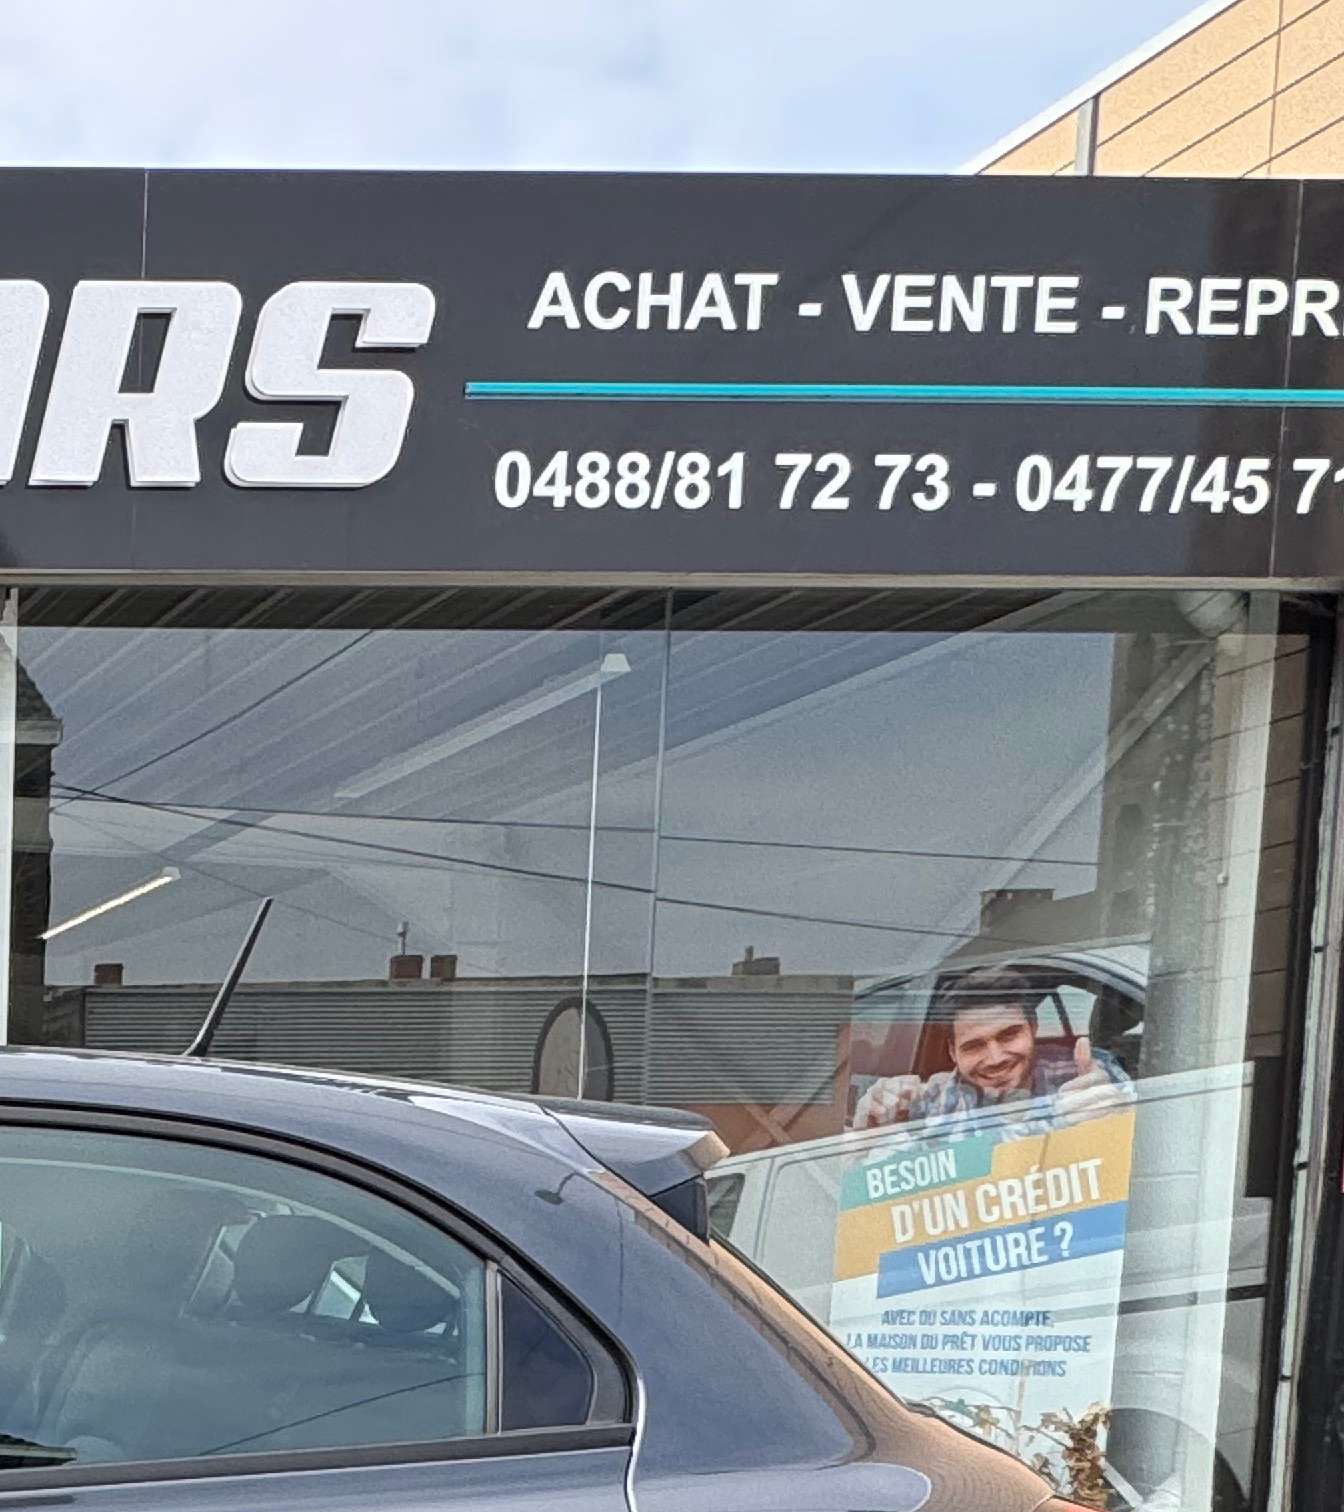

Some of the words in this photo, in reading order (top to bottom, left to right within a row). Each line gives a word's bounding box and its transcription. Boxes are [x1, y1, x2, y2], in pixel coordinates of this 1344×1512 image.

[527, 271, 779, 331] ACHAT
[799, 302, 822, 316] -
[841, 273, 1080, 334] VENTE
[1101, 305, 1125, 319] -
[494, 450, 746, 510] 0488/81
[775, 453, 852, 510] 72
[874, 453, 949, 511] 73
[1016, 454, 1271, 515] 0477/45
[866, 1149, 957, 1200] BESOIN
[890, 1190, 970, 1244] D'UN
[975, 1157, 1104, 1224] CRÉDIT
[917, 1226, 1050, 1286] VOITURE
[867, 1333, 918, 1350] MAISON
[920, 1333, 939, 1350] DU
[942, 1331, 979, 1351] PRÊT
[982, 1335, 1023, 1351] VOUS
[1025, 1335, 1092, 1353] PROPOSE
[881, 1310, 916, 1327] AVEC
[919, 1310, 937, 1327] OU
[940, 1310, 977, 1328] SANS
[892, 1357, 975, 1375] MEILLEURES
